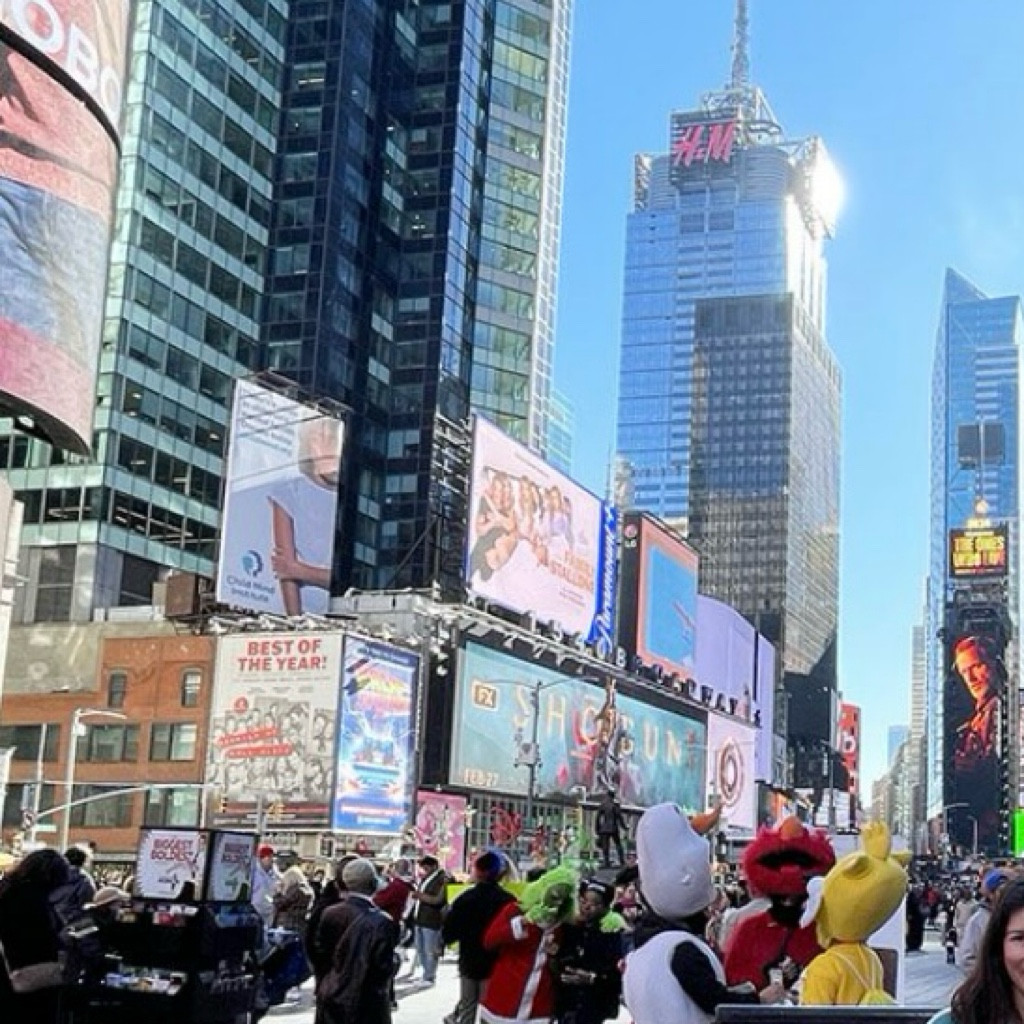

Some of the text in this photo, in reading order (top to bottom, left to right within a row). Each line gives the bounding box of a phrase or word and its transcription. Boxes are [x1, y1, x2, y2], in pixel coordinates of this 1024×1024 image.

[673, 121, 734, 167] H&M
[247, 638, 323, 656] BEST OF
[238, 655, 328, 672] THE YEAR!
